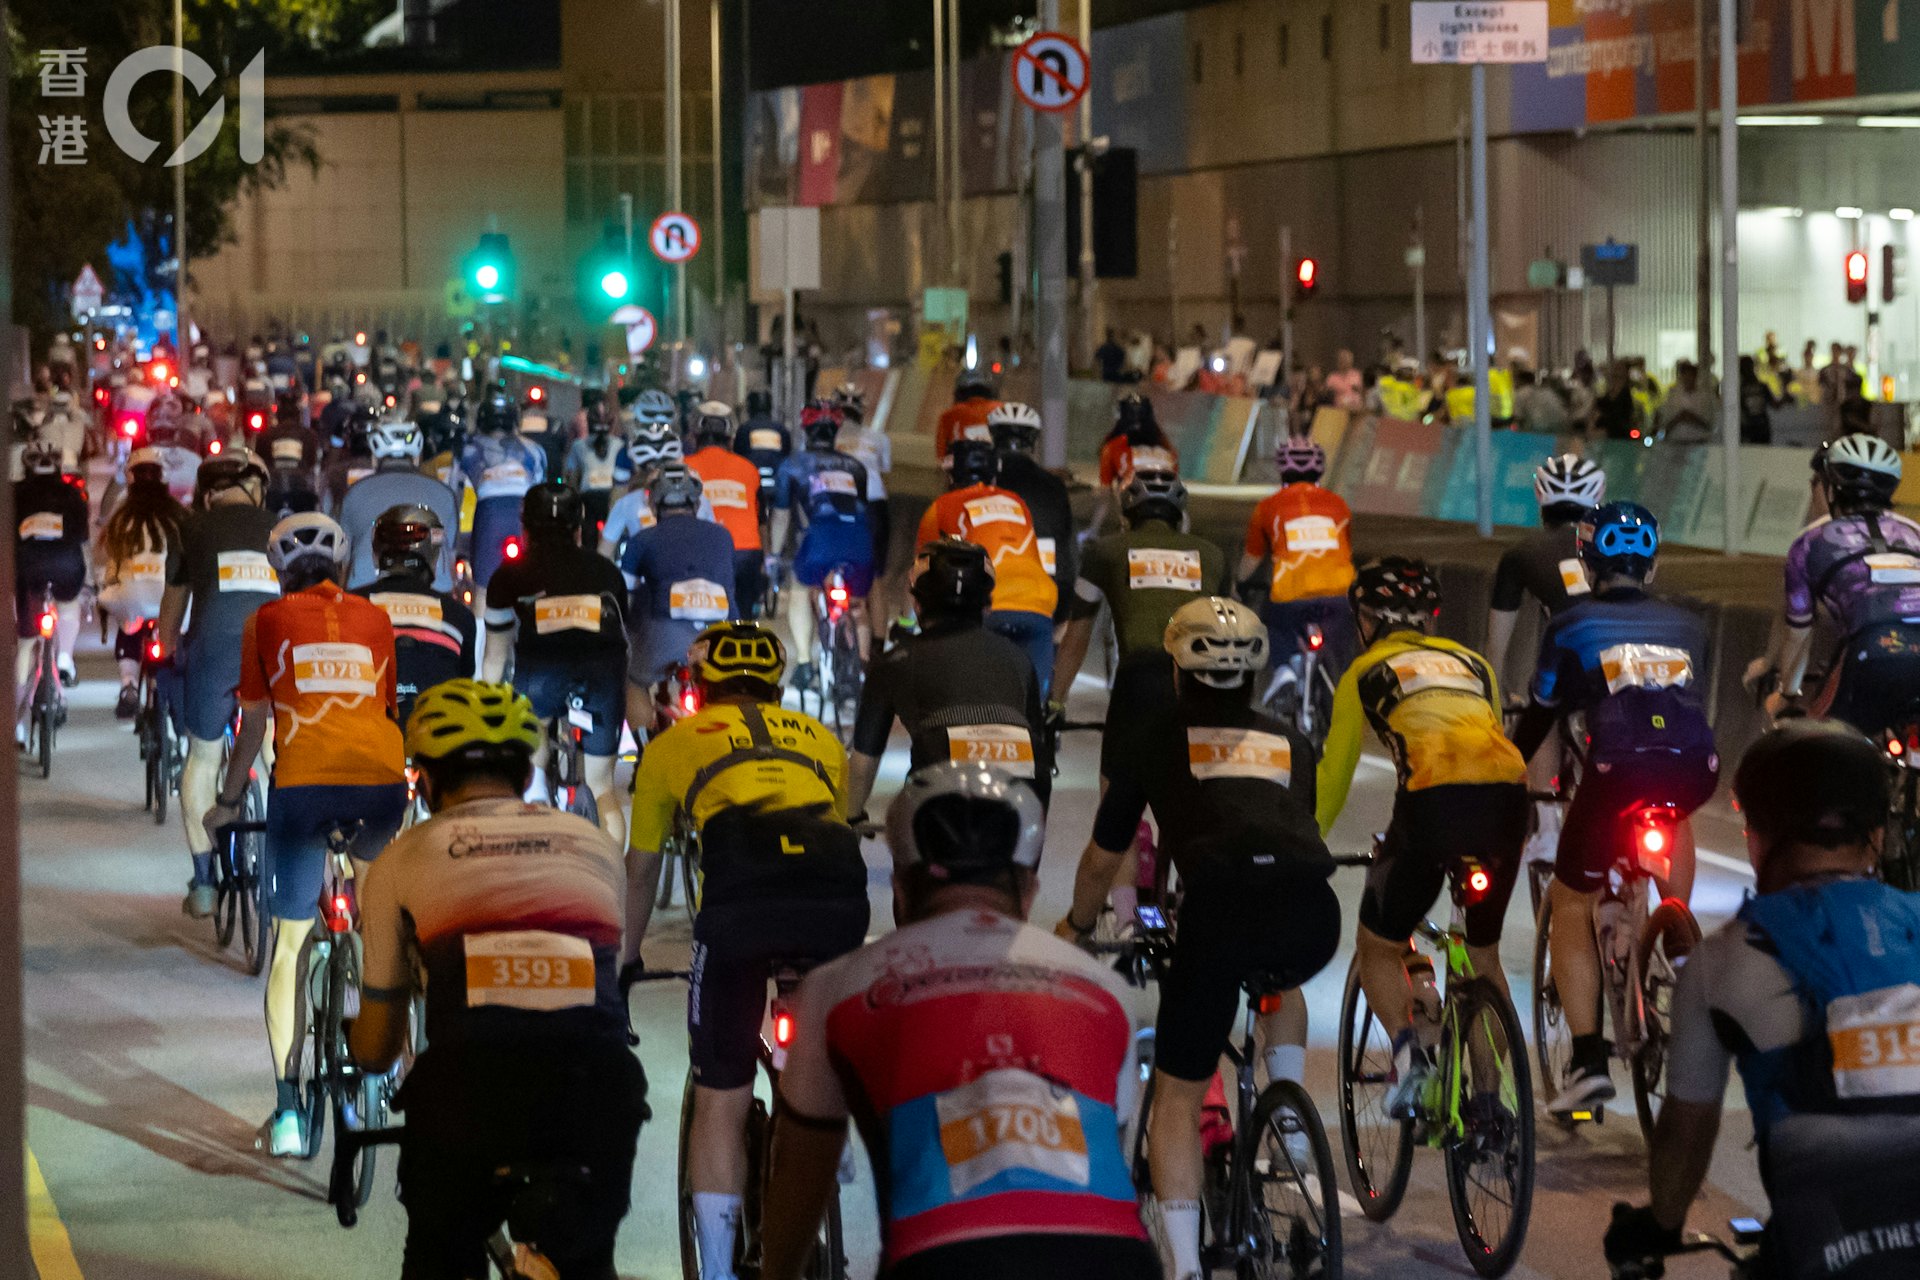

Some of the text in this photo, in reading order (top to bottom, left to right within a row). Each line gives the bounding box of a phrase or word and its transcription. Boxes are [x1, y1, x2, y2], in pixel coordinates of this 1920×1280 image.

[311, 661, 362, 678] 1978
[967, 741, 1019, 760] 2278
[491, 959, 571, 986] 3593
[1824, 1222, 1915, 1272] RIDE THE
